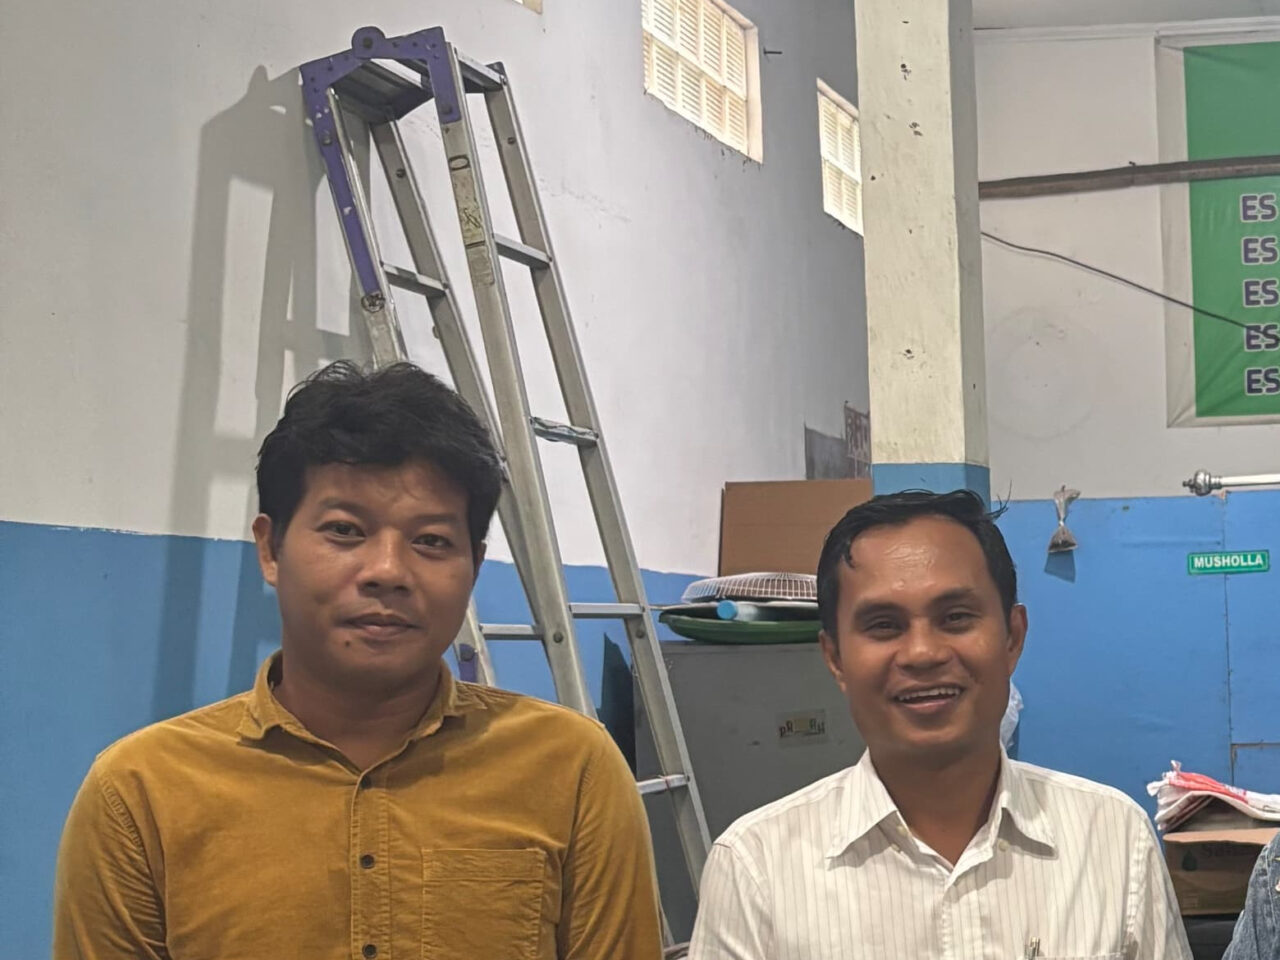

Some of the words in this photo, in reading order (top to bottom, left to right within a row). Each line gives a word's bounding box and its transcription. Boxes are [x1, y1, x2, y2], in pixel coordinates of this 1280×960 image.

[1240, 193, 1277, 222] ES
[1241, 236, 1278, 265] ES
[1243, 279, 1279, 307] ES
[1245, 323, 1280, 351] ES
[1246, 366, 1280, 394] ES
[1194, 554, 1263, 568] MUSHOLLA
